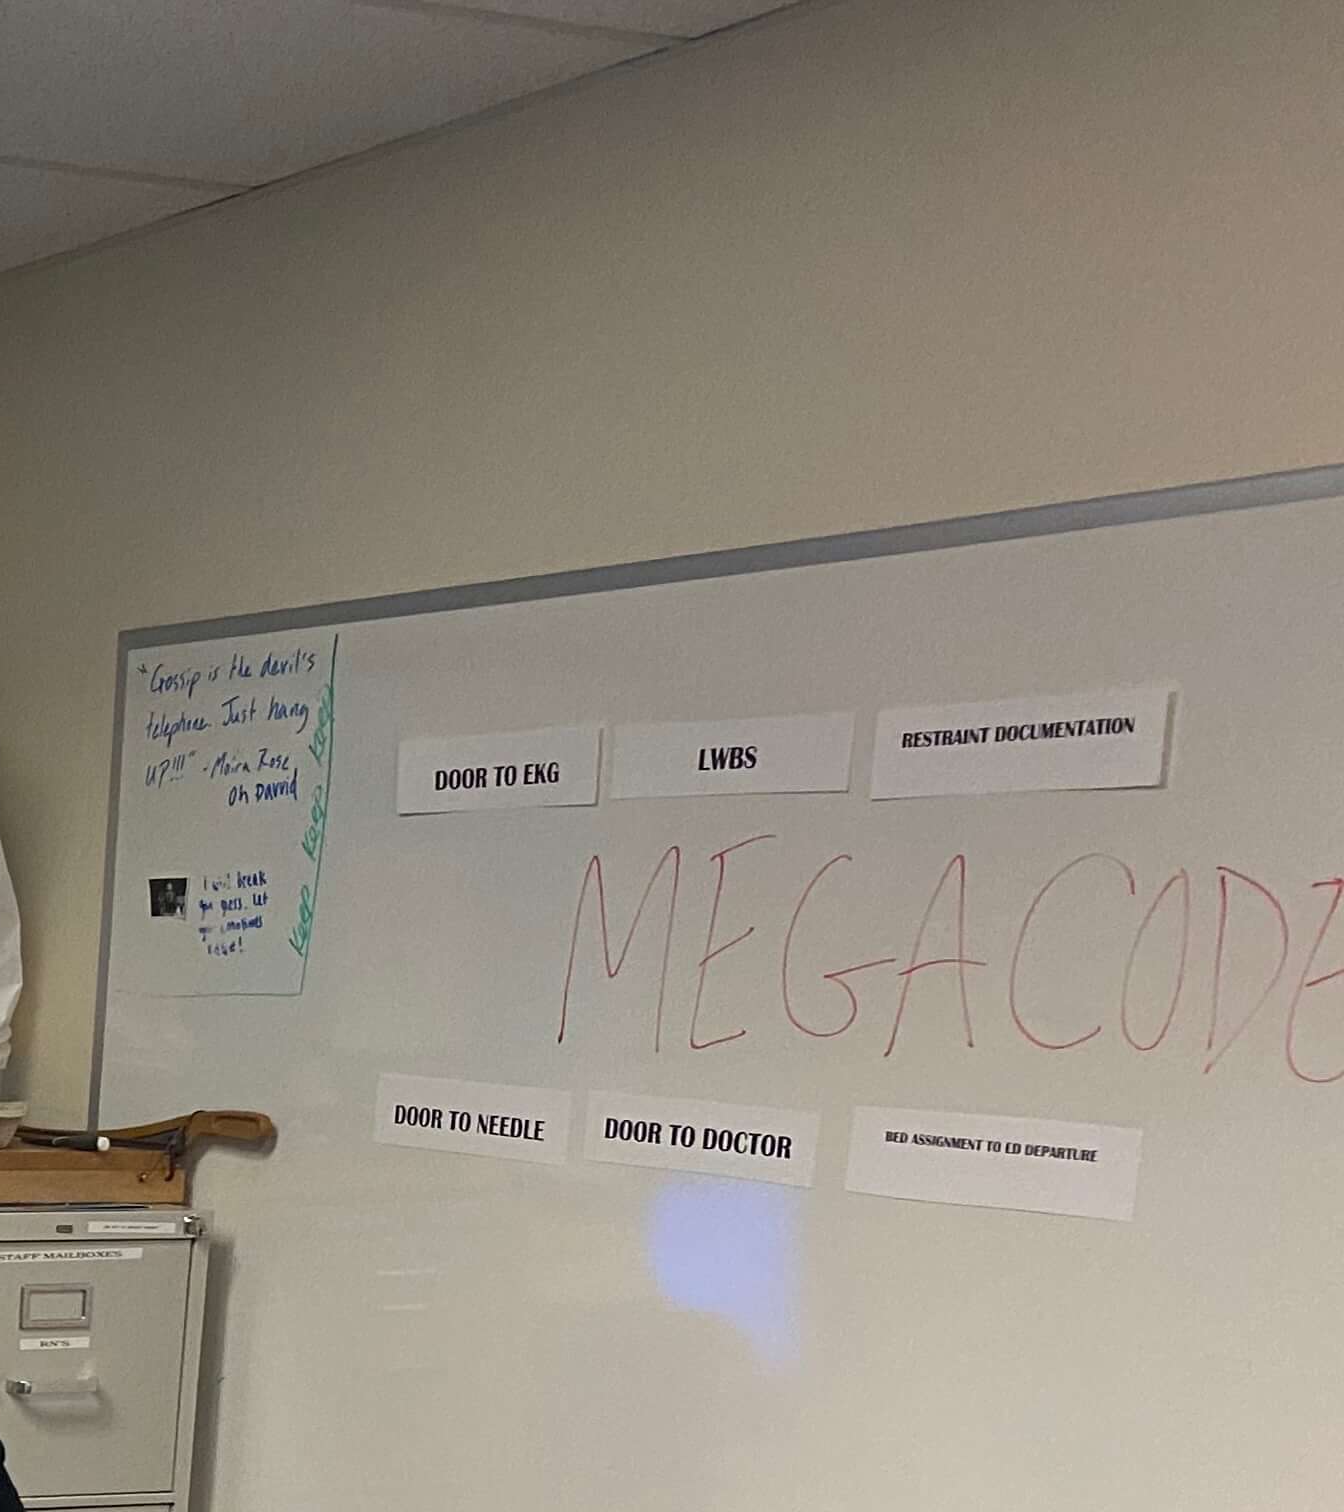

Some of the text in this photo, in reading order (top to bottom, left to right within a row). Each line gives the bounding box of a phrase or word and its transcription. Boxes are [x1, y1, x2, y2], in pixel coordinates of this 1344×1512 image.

[221, 695, 257, 727] Just
[267, 696, 310, 735] hang
[902, 716, 1137, 750] RESTRAINT DOCUMENTATION
[698, 745, 758, 772] LWBS
[434, 762, 561, 792] DOOR TO EKG
[393, 1103, 545, 1142] DOOR TO NEEDLE
[604, 1117, 793, 1160] DOOR TO DOCTOR
[885, 1130, 909, 1145] BED
[912, 1132, 983, 1153] ASSIGNMENT
[986, 1138, 1002, 1154] TO
[1024, 1142, 1099, 1164] DEPARTURE
[44, 1250, 123, 1260] MAILBOXES
